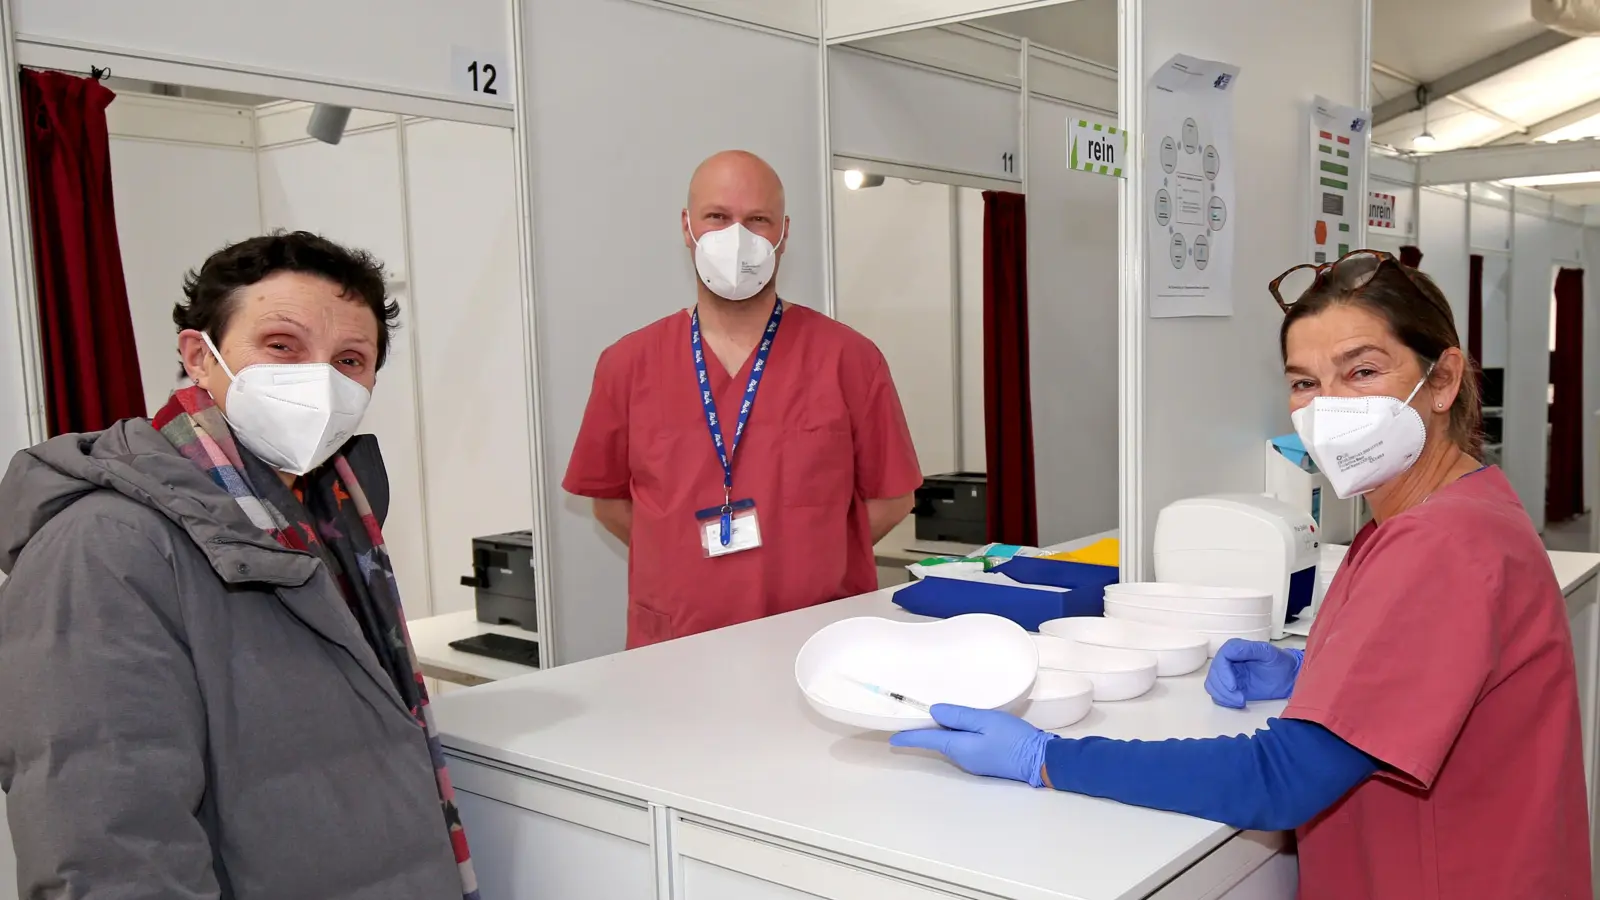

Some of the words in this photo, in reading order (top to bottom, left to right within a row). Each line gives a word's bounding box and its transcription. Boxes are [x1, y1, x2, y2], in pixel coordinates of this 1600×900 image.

[467, 60, 498, 95] 12
[1002, 151, 1013, 173] 11
[1088, 136, 1114, 164] rein
